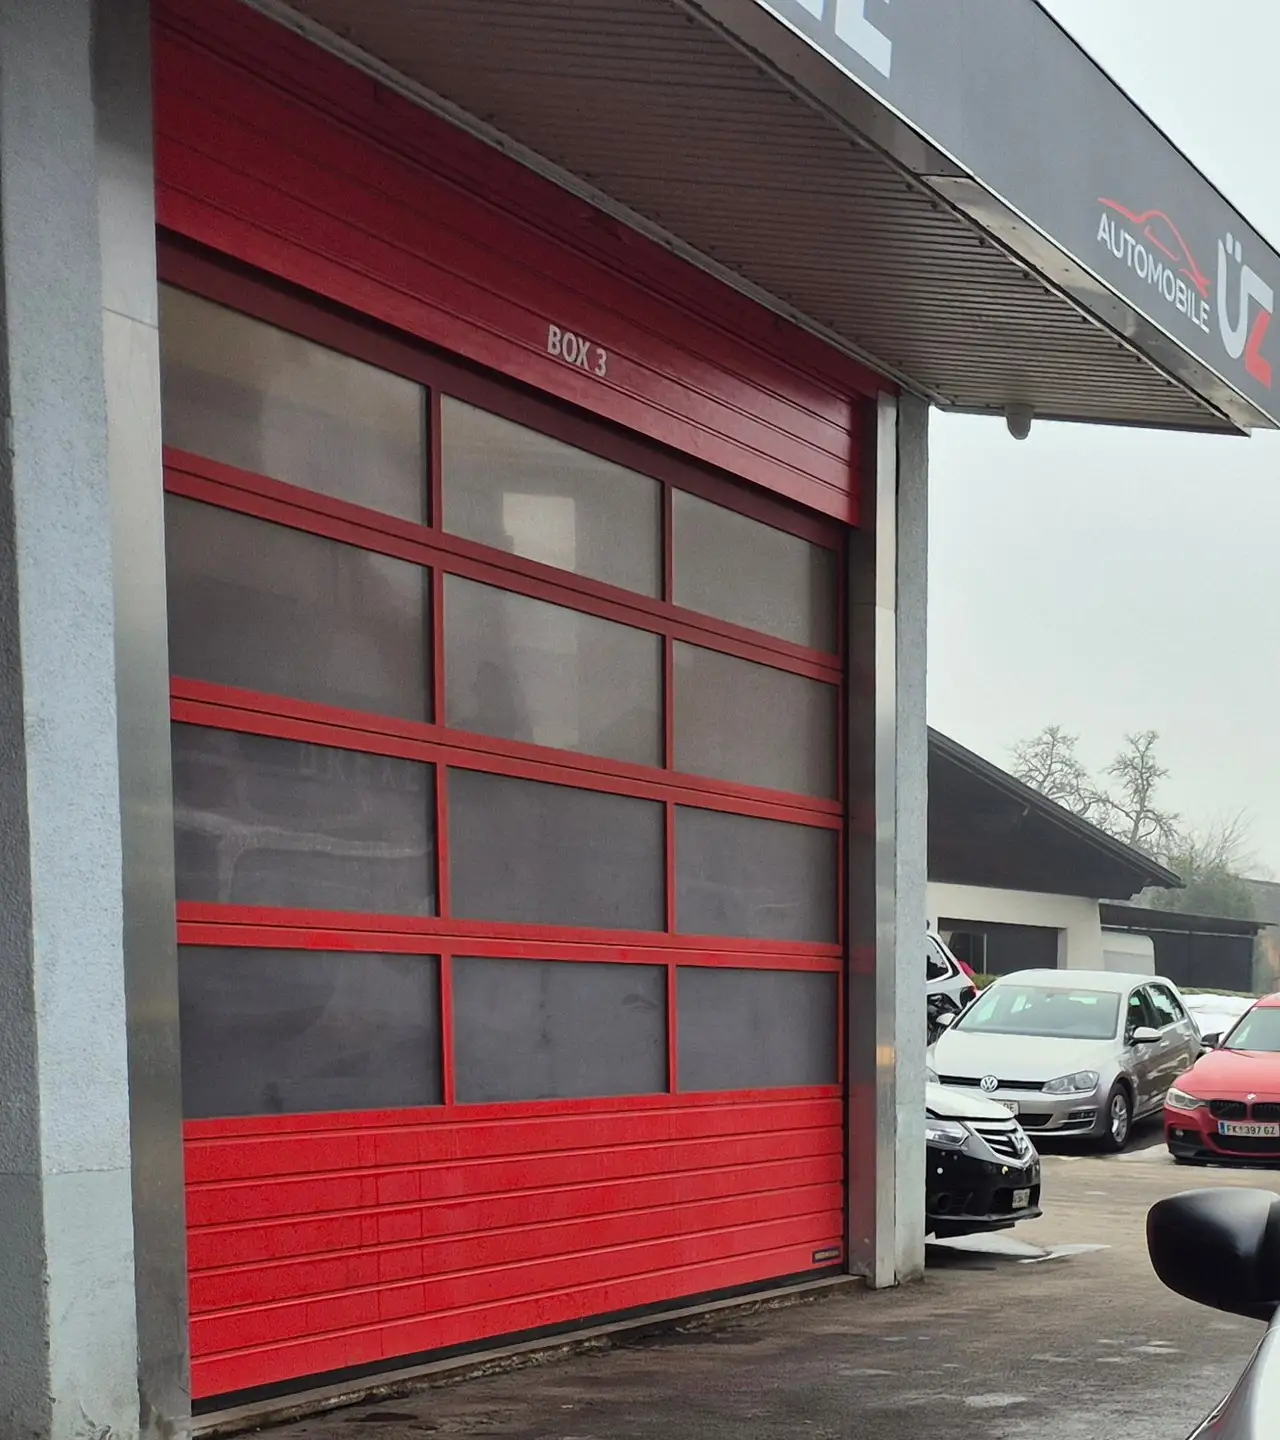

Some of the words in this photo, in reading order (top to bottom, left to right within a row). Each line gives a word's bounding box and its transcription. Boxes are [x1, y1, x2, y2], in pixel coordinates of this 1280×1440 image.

[1097, 212, 1211, 334] AUTOMOBILE
[1217, 232, 1274, 390] ÜZ
[547, 324, 592, 371] BOX
[595, 348, 607, 377] 3
